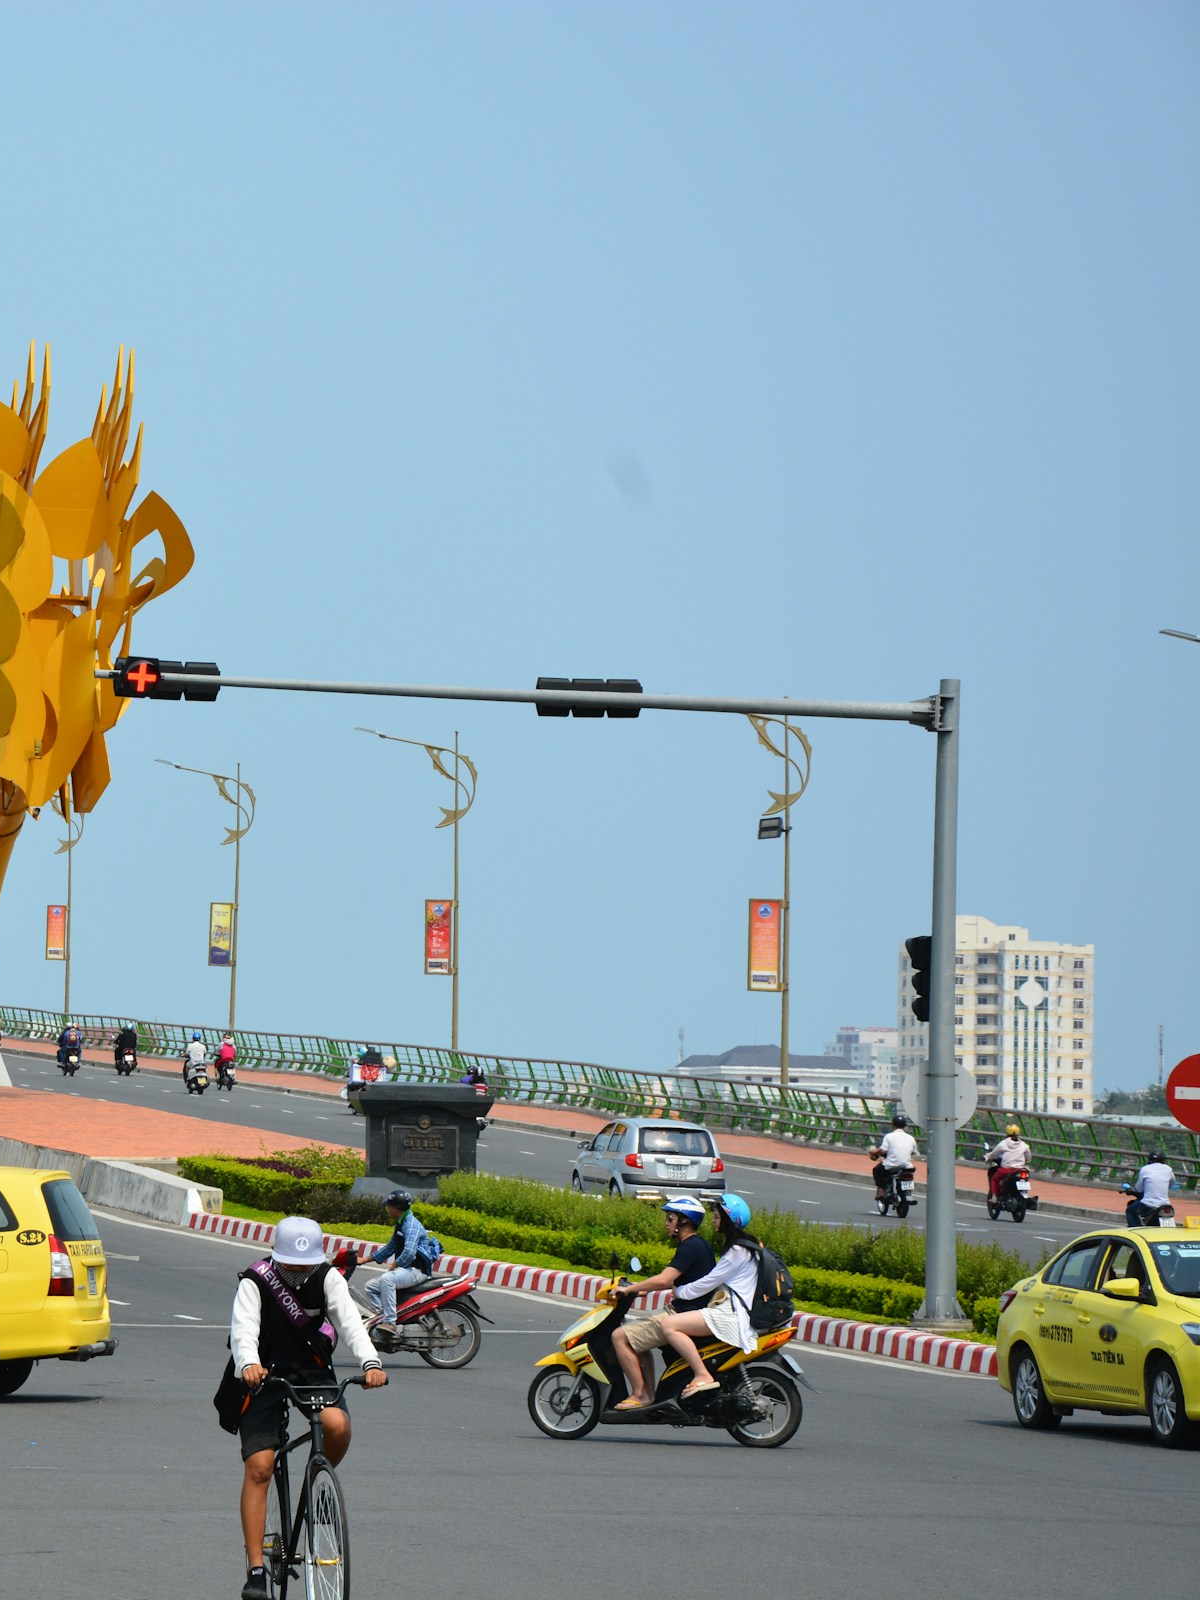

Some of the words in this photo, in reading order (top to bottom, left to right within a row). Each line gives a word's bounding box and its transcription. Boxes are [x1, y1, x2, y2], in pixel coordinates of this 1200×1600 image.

[257, 1263, 282, 1290] NEW
[278, 1287, 303, 1320] YORK
[1090, 1351, 1102, 1362] TAXI
[1117, 1353, 1125, 1365] SA
